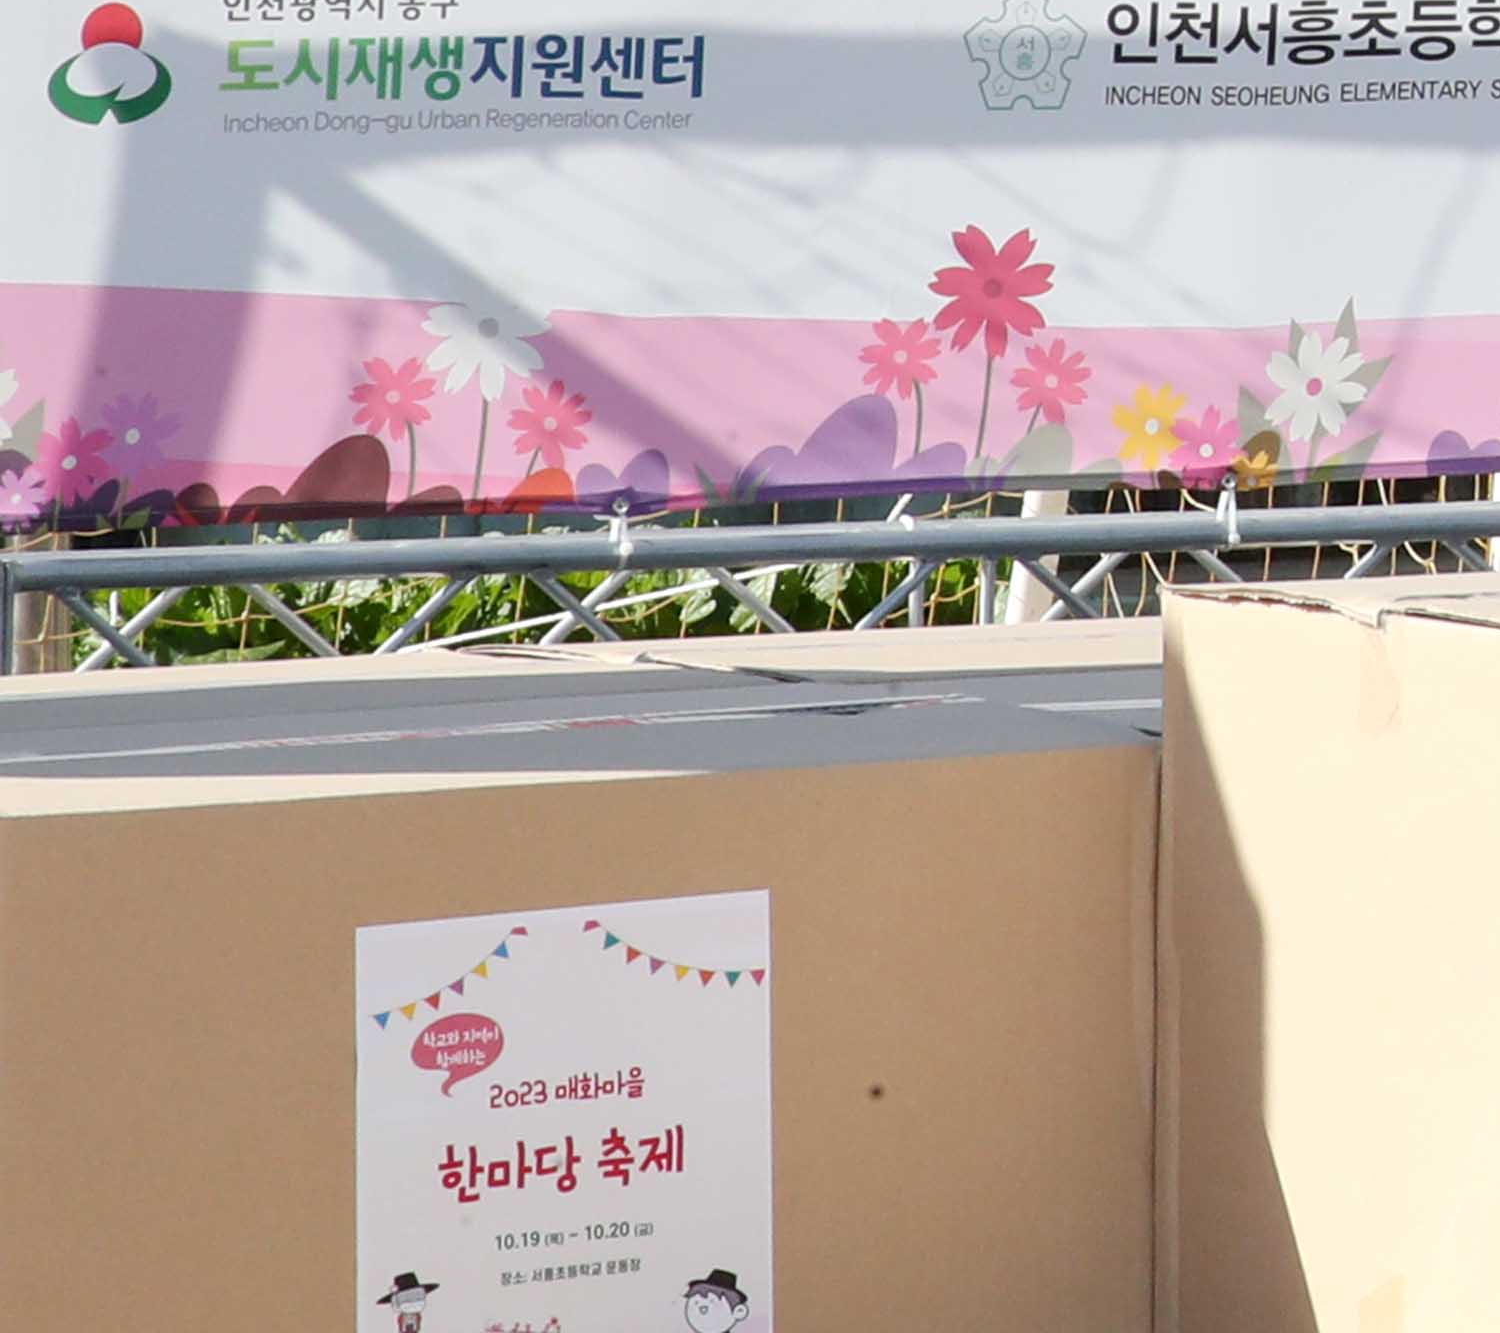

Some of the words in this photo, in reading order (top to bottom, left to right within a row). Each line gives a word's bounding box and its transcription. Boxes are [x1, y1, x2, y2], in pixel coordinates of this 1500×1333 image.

[219, 35, 704, 100] 도시재생지원센터
[1106, 86, 1202, 105] INCHEON
[1211, 84, 1330, 106] SEOHEUNG
[1340, 80, 1482, 102] ELEMENTARY
[224, 112, 309, 133] Incheon
[418, 109, 480, 130] Urban
[487, 108, 613, 132] Regeneration
[623, 109, 693, 130] Center
[491, 1080, 547, 1108] 2023
[555, 1067, 644, 1099] 매화마을
[439, 1136, 581, 1203] 한마당
[598, 1125, 683, 1186] 축제
[496, 1231, 540, 1250] 10.19
[586, 1221, 629, 1240] 10.20
